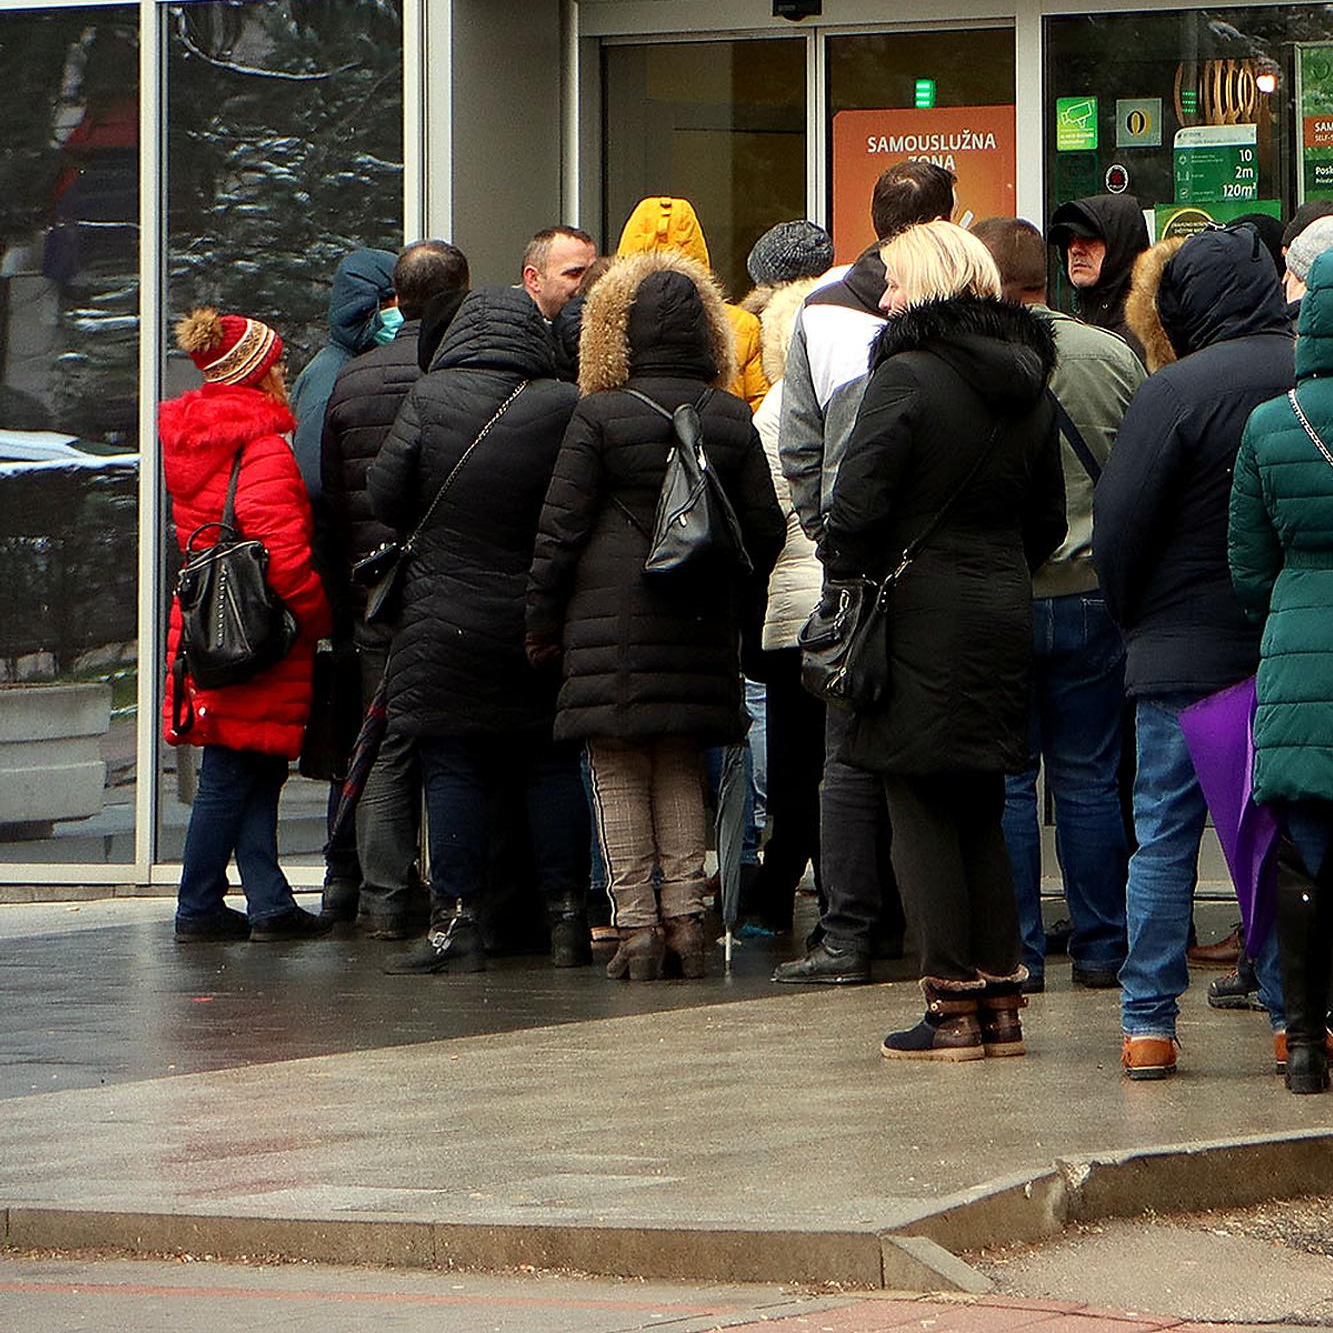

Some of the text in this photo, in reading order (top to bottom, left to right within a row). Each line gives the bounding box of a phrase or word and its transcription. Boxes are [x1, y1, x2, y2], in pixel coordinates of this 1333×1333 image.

[867, 129, 997, 153] SAMOUSLUŽNA
[1239, 149, 1253, 162] 10
[1235, 166, 1254, 179] 2m
